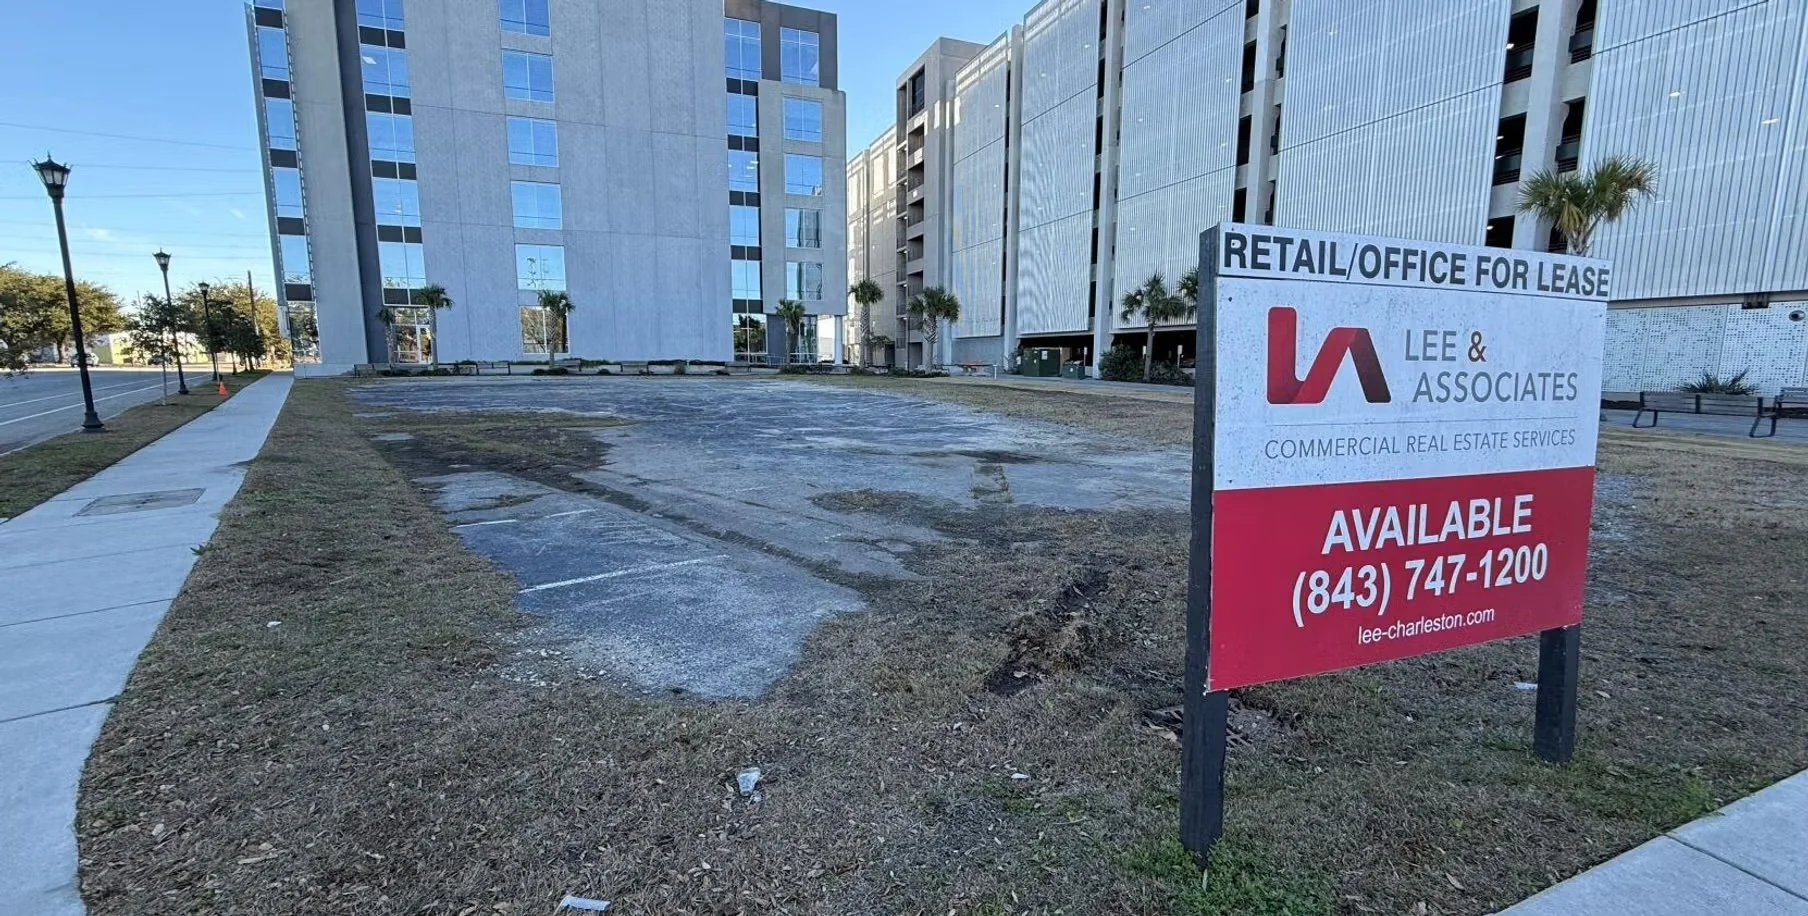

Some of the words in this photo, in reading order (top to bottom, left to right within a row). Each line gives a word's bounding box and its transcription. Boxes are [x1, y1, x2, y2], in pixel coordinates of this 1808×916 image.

[1223, 231, 1467, 285] RETAIL/OFFICE
[1475, 255, 1529, 290] FOR
[1537, 262, 1610, 297] LEASE
[1405, 329, 1457, 361] LEE
[1467, 330, 1487, 363] &
[1413, 371, 1578, 403] ASSOCIATES
[1264, 436, 1400, 459] COMMERCIAL
[1406, 434, 1448, 453] REAL
[1454, 431, 1509, 451] ESTATE
[1513, 429, 1576, 448] SERVICES
[1321, 493, 1534, 555] AVAILABLE
[1292, 562, 1391, 627] (843)
[1405, 542, 1548, 601] 747-1200
[1358, 607, 1495, 645] lee-charleston.com
